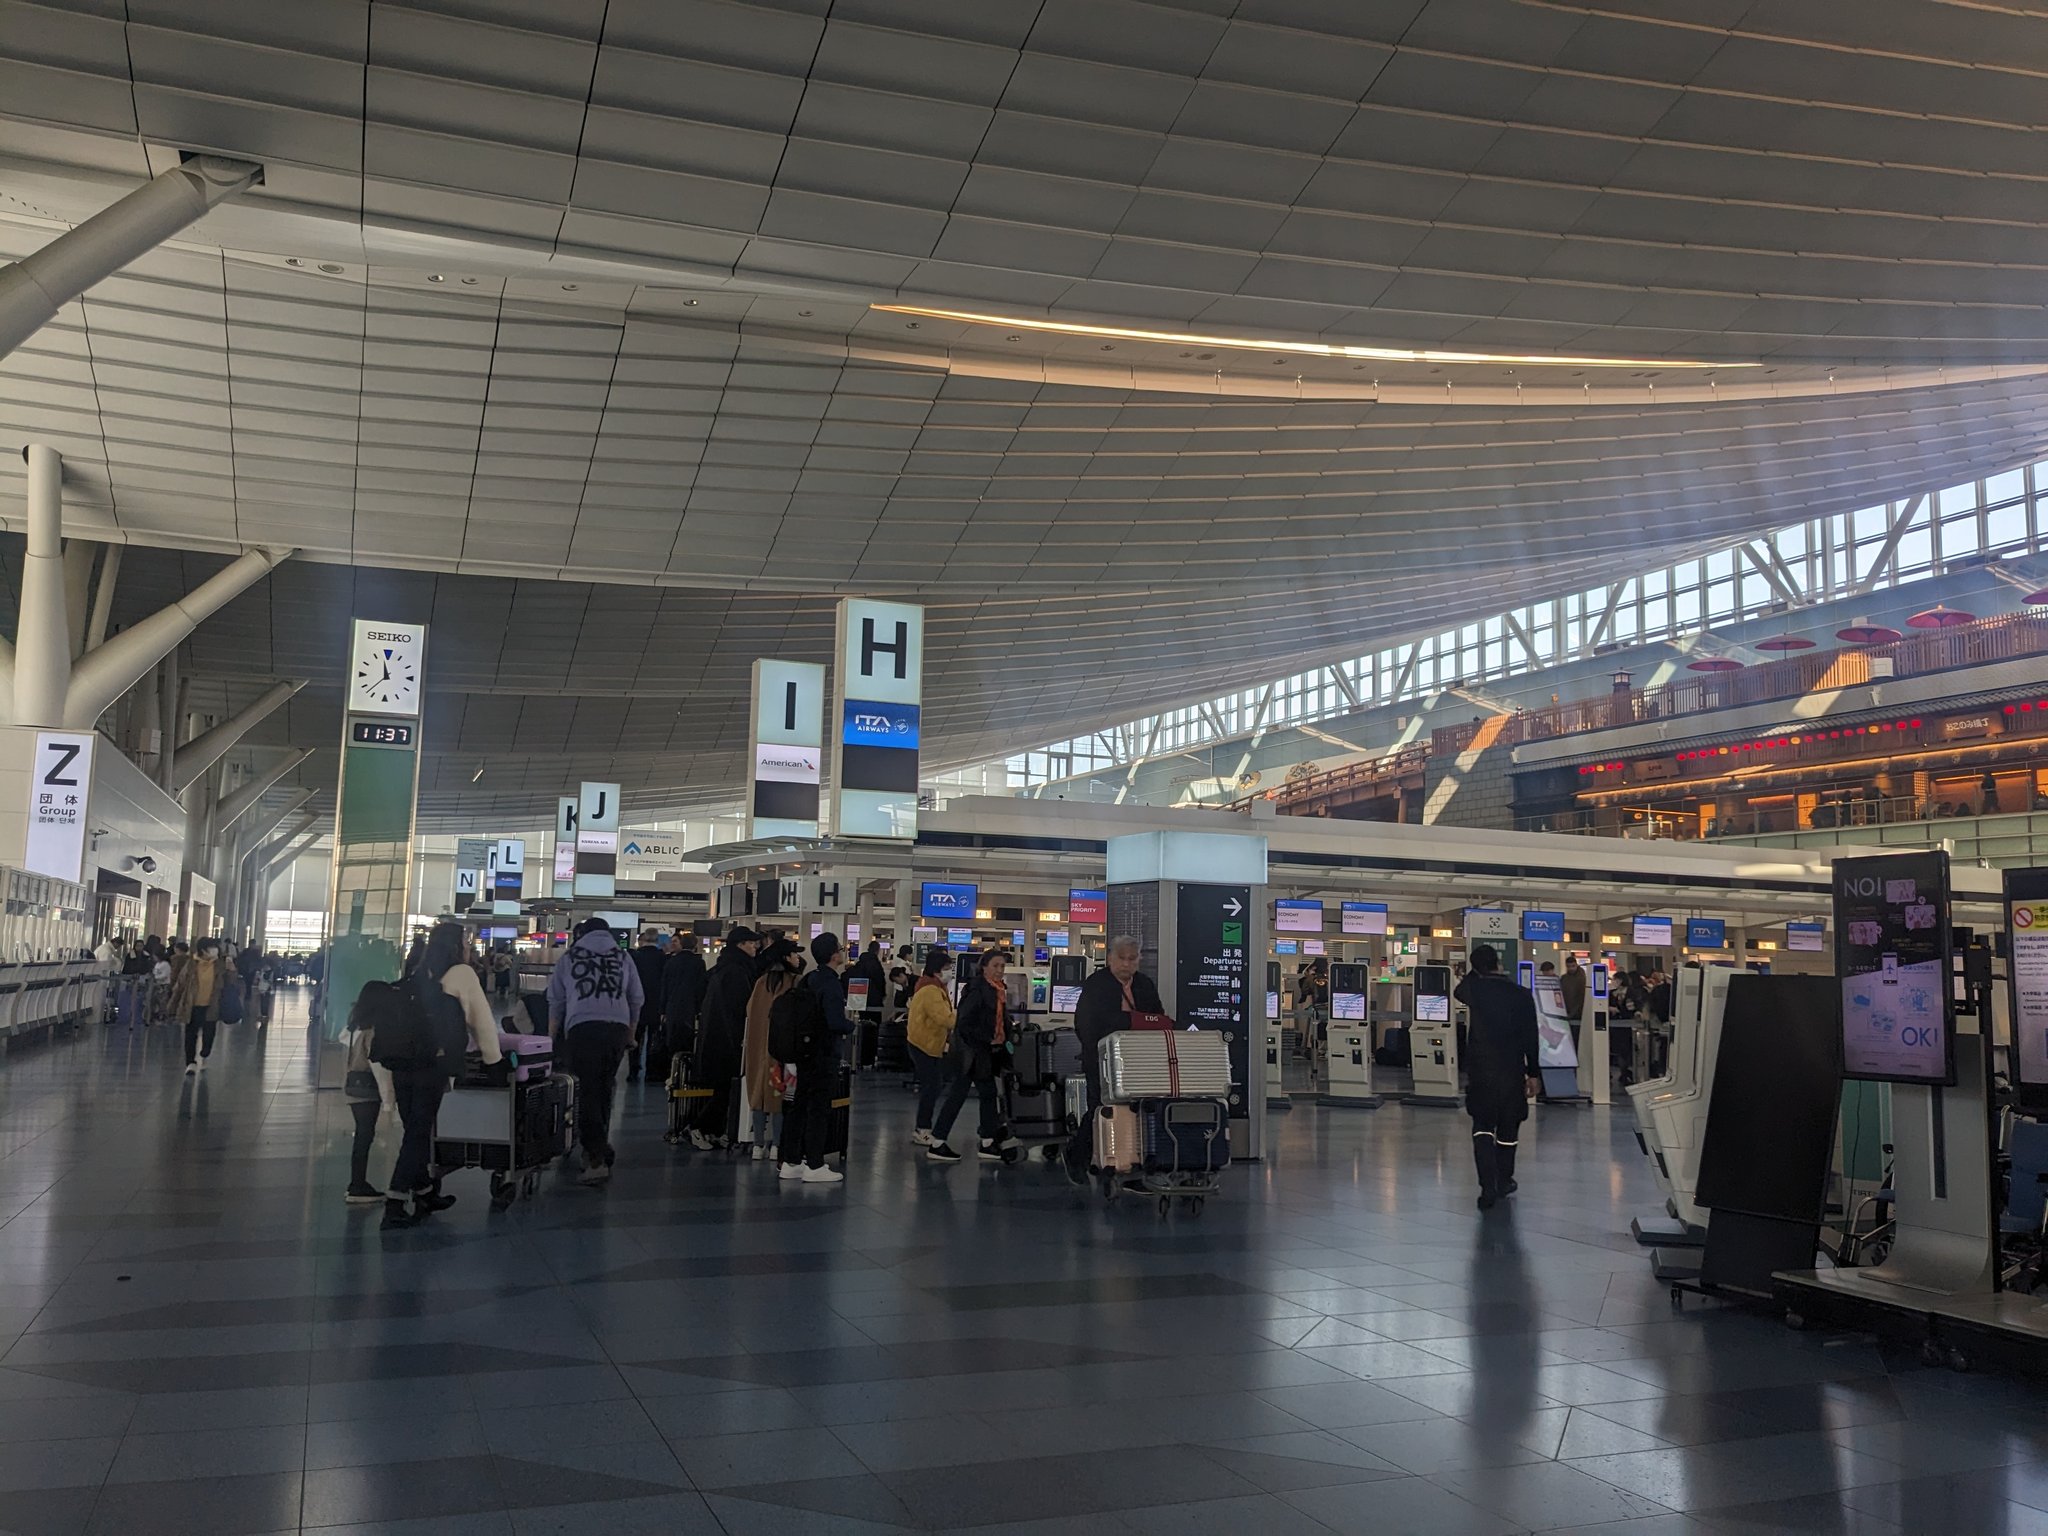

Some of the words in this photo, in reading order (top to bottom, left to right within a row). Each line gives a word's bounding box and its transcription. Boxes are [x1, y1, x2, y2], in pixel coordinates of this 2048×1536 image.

[367, 631, 412, 643] SEIKO
[861, 617, 907, 680] H
[785, 681, 797, 730] I
[855, 714, 891, 727] ITA
[363, 727, 407, 742] 11:37
[857, 725, 890, 733] AIRWAYS
[44, 743, 80, 787] Z
[761, 758, 803, 768] American
[39, 793, 78, 805] 団体
[591, 791, 606, 820] J
[39, 806, 77, 817] Group
[565, 805, 578, 831] K
[505, 845, 517, 865] L
[644, 845, 680, 855] ABLIC
[460, 873, 474, 888] N
[1844, 877, 1882, 897] NO!
[787, 882, 797, 906] H
[819, 882, 839, 907] H
[930, 894, 956, 903] ITA
[1529, 920, 1549, 928] ITA
[1222, 948, 1242, 957] 出発
[1203, 956, 1242, 965] Departures
[1902, 1026, 1938, 1047] OK!
